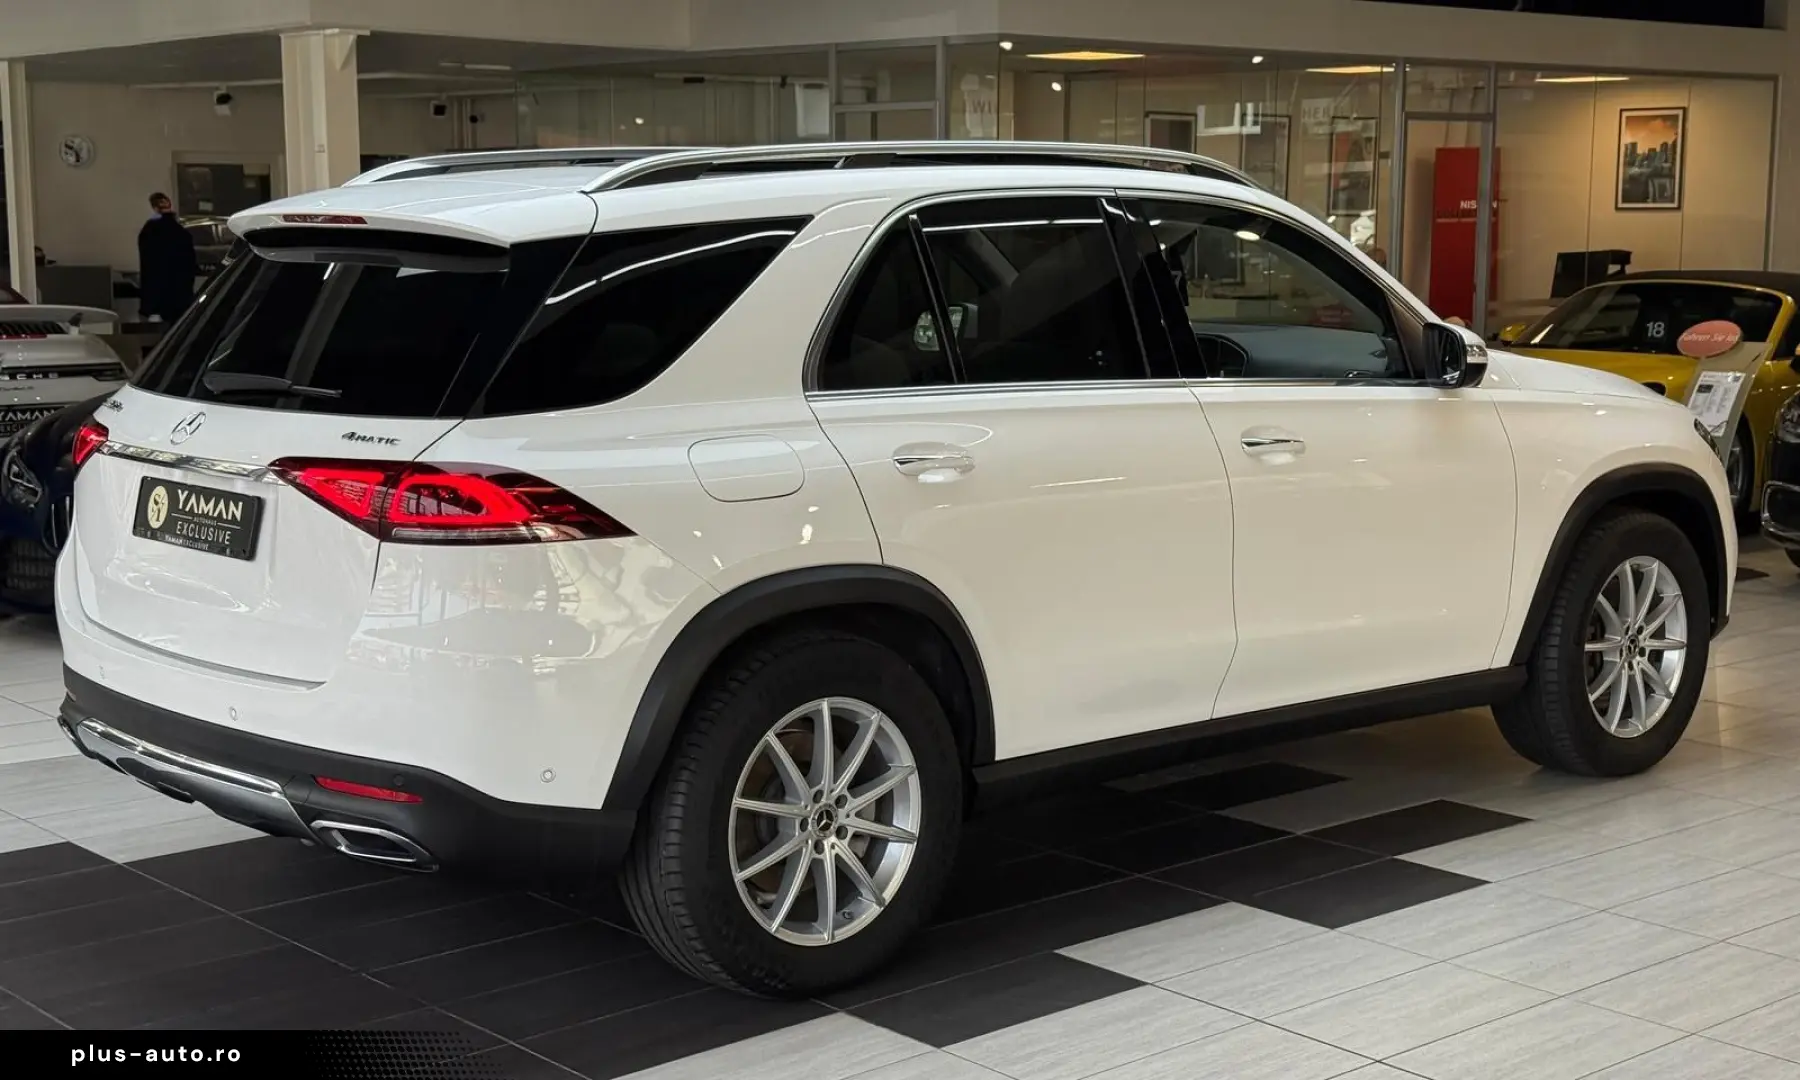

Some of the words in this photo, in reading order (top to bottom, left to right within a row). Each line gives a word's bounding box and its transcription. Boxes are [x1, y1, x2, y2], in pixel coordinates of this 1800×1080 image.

[1646, 322, 1665, 338] 18
[177, 488, 243, 522] YAMAN
[175, 521, 232, 545] EXCLUSIVE
